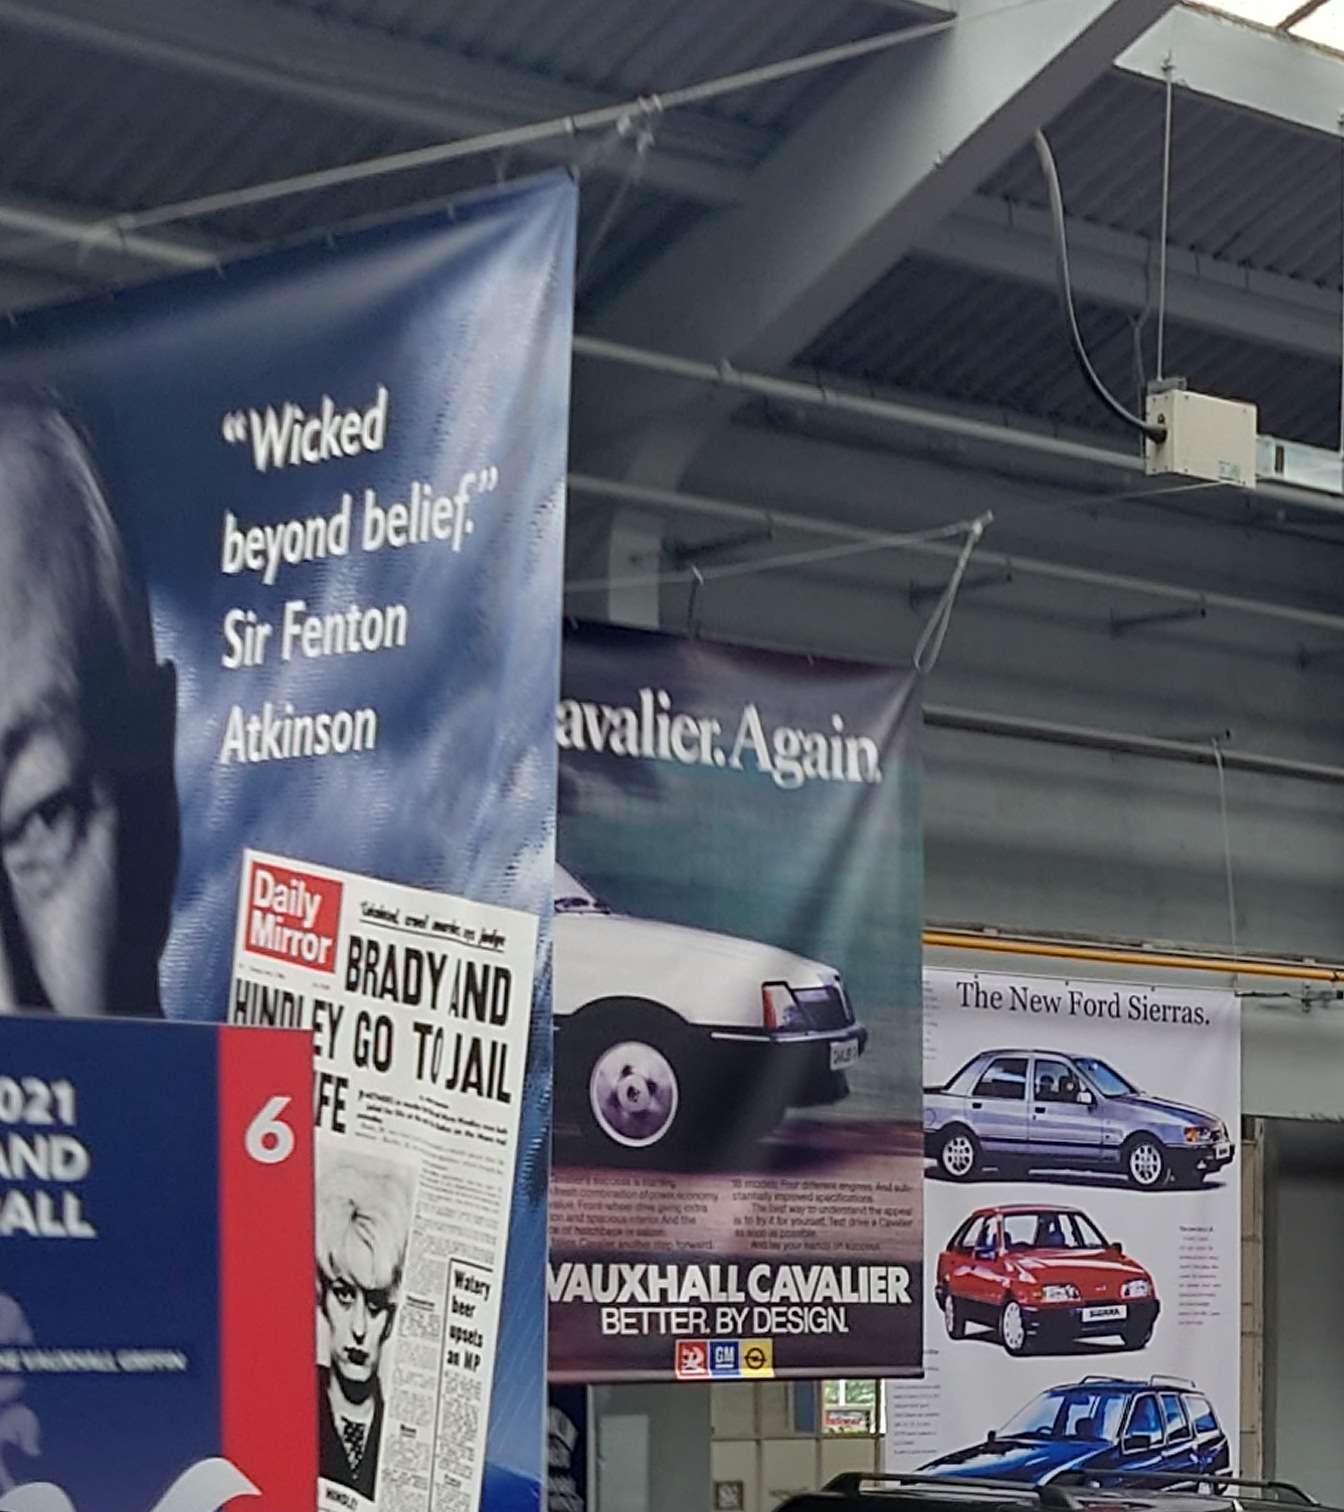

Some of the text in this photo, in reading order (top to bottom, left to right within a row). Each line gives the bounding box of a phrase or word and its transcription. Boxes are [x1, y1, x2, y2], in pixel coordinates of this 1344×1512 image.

[222, 386, 389, 471] “Wicked
[222, 492, 351, 585] beyond
[222, 600, 408, 669] Sir Fenton
[220, 704, 377, 766] Atkinson
[253, 870, 322, 928] Daily
[250, 910, 333, 965] Mirror
[345, 934, 513, 1028] BRADY AND
[957, 981, 1211, 1026] The New Ford Sierras.
[353, 1010, 394, 1073] GO
[413, 1020, 445, 1085] TO
[445, 1033, 513, 1104] JAIL
[245, 1096, 296, 1164] 6
[314, 1071, 349, 1134] FE
[452, 1296, 475, 1317] beer
[548, 1261, 912, 1305] VAUXHALL CAVALIER
[601, 1306, 849, 1336] BETTER. BY DESIGN.
[715, 1346, 735, 1363] GM
